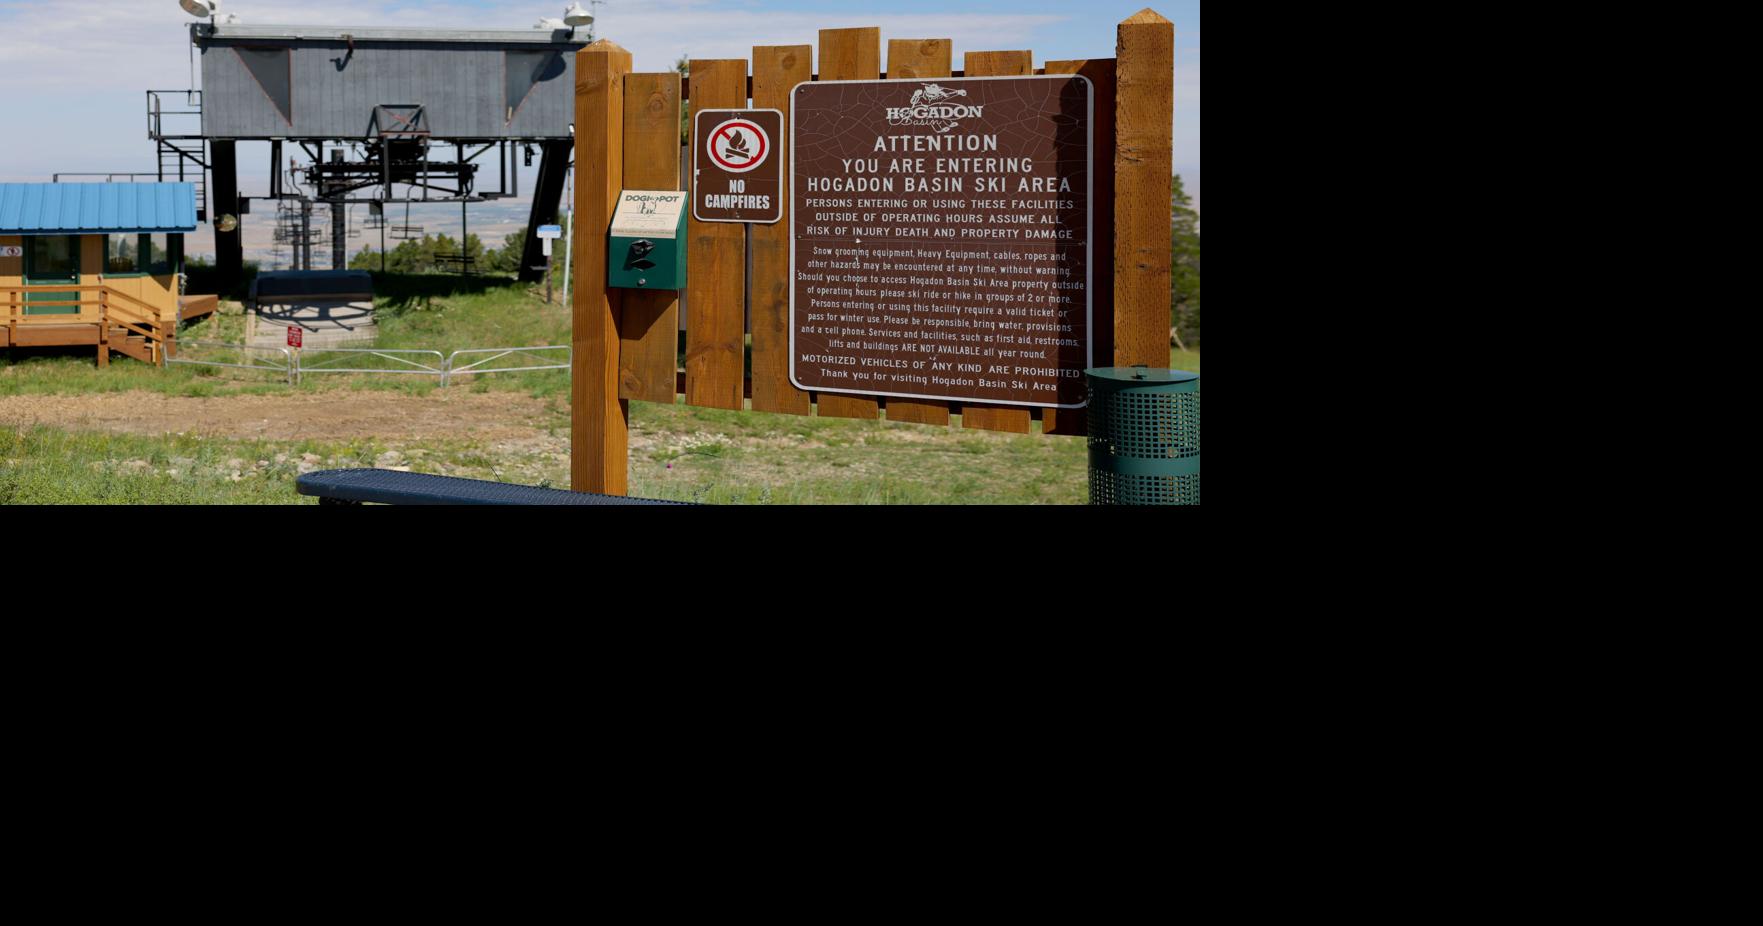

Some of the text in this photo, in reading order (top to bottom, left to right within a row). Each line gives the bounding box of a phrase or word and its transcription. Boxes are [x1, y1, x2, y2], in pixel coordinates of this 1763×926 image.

[886, 106, 983, 119] HOGADON
[874, 134, 997, 151] ATTENTION
[842, 158, 1033, 174] YOU ARE ENTERING
[729, 180, 744, 193] NO
[807, 177, 1072, 193] HOGADON BASIN SKI AREA
[705, 194, 770, 209] CAMPFIRES
[806, 198, 1074, 210] PERSONS ENTERING OR USING THESE FACILITIES
[815, 212, 1062, 224] OUTSIDE OF OPERATING HOURS ASSUME ALL
[806, 226, 1073, 239] RISK OF INJURY DEATH AND PROPERTY DAMAGE
[814, 246, 832, 255] Snow
[835, 248, 869, 258] grooming
[918, 249, 942, 260] Heavy
[1024, 252, 1047, 262] ropes
[1050, 252, 1066, 260] and
[831, 260, 860, 269] hazards
[864, 262, 880, 271] may
[895, 263, 942, 272] encountered
[958, 265, 973, 274] any
[1000, 265, 1032, 274] without
[798, 272, 822, 280] Should
[826, 274, 840, 282] you
[910, 276, 943, 287] Hogadon
[948, 277, 970, 286] Basin
[990, 279, 1008, 288] Area
[1012, 280, 1048, 290] property
[1052, 282, 1084, 290] outside
[816, 286, 852, 296] operating
[880, 289, 905, 298] please
[924, 290, 939, 298] ride
[955, 291, 970, 300] hike
[986, 294, 1014, 302] groups
[1028, 294, 1033, 302] 2
[811, 299, 840, 308] Persons
[842, 301, 874, 311] entering
[889, 304, 910, 313] using
[932, 304, 961, 314] facility
[964, 306, 994, 317] require
[1006, 307, 1026, 316] valid
[1030, 308, 1054, 316] ticket
[1058, 309, 1068, 317] or
[808, 314, 824, 322] pass
[884, 316, 908, 324] Please
[912, 317, 920, 325] be
[974, 319, 994, 330] bring
[1026, 322, 1072, 332] provisions
[868, 328, 900, 338] Services
[904, 330, 918, 338] and
[996, 334, 1014, 343] first
[829, 340, 844, 348] lifts
[846, 340, 860, 348] and
[864, 342, 898, 352] buildings
[902, 343, 916, 352] ARE
[920, 344, 934, 352] NOT
[938, 346, 980, 355] AVAILABLE
[984, 348, 994, 356] all
[998, 350, 1016, 358] year
[802, 354, 1080, 378] MOTORIZED VEHICLES OF ANY KIND ARE PROHIBITED
[822, 368, 848, 378] Thank
[853, 372, 869, 380] you
[891, 374, 927, 385] visiting
[932, 376, 974, 386] Hogadon
[979, 379, 1006, 388] Basin
[1012, 380, 1028, 389] Ski
[1033, 382, 1056, 391] Area
